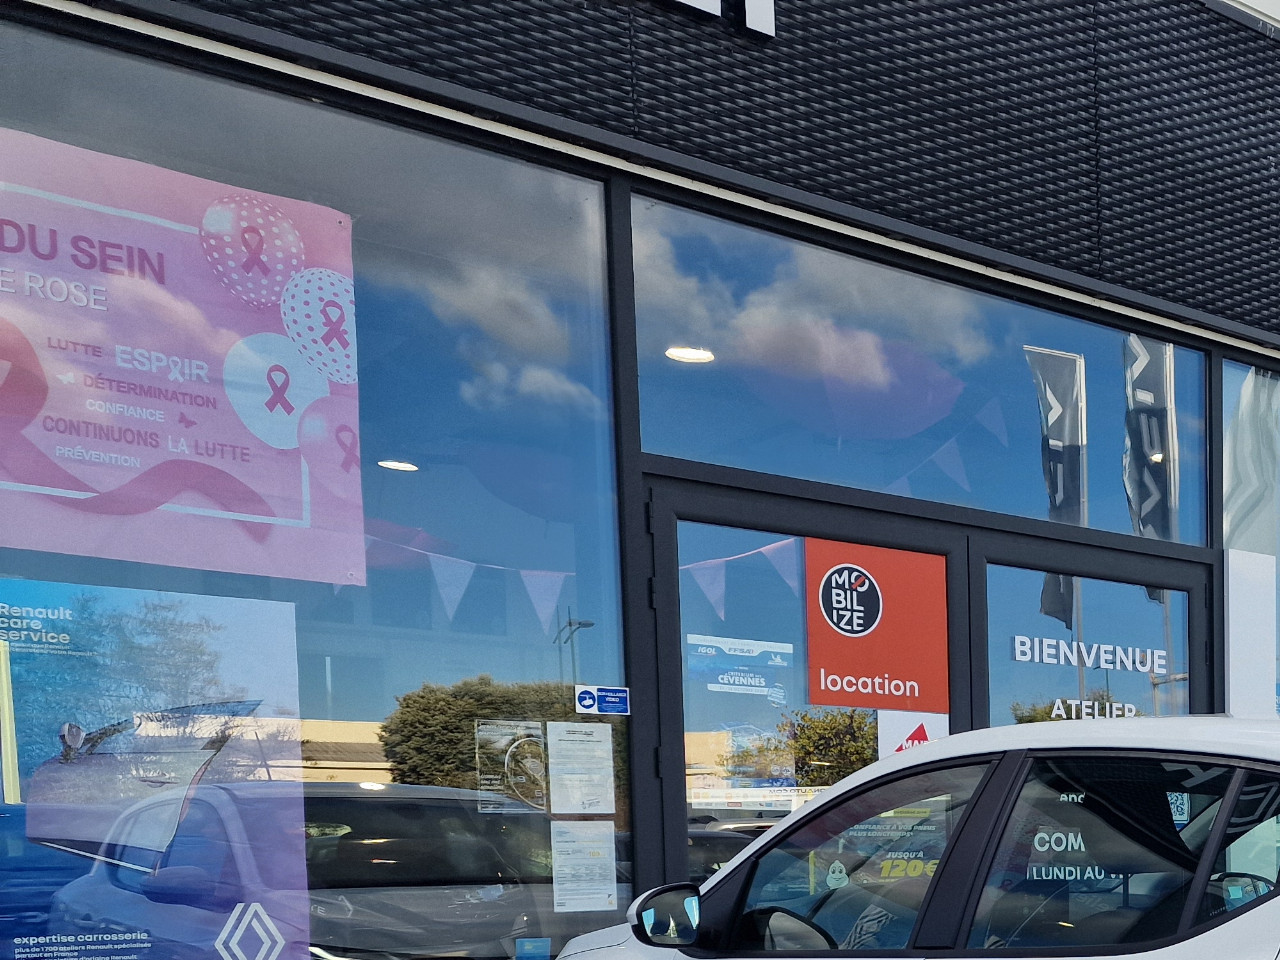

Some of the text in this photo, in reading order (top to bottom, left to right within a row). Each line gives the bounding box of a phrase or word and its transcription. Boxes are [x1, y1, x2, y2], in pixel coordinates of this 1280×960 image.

[0, 218, 166, 285] DU SEIN
[24, 271, 108, 311] ROSE
[47, 337, 102, 357] LUTTE
[83, 373, 217, 409] DÉTERMINATION
[86, 399, 164, 422] CONFIANCE
[42, 415, 250, 463] CONTINUONS LA LUTTE
[55, 445, 140, 468] PRÉVENTION
[0, 603, 72, 620] Renault
[0, 629, 70, 643] service
[698, 646, 716, 654] IGOL
[1014, 635, 1167, 674] BIENVENUE
[718, 673, 766, 686] CÉVENNES
[820, 668, 919, 697] location
[1050, 698, 1136, 720] ATELIER
[1032, 866, 1080, 880] LUNDI
[1084, 866, 1105, 880] AU
[14, 931, 148, 945] expertise carrosserie
